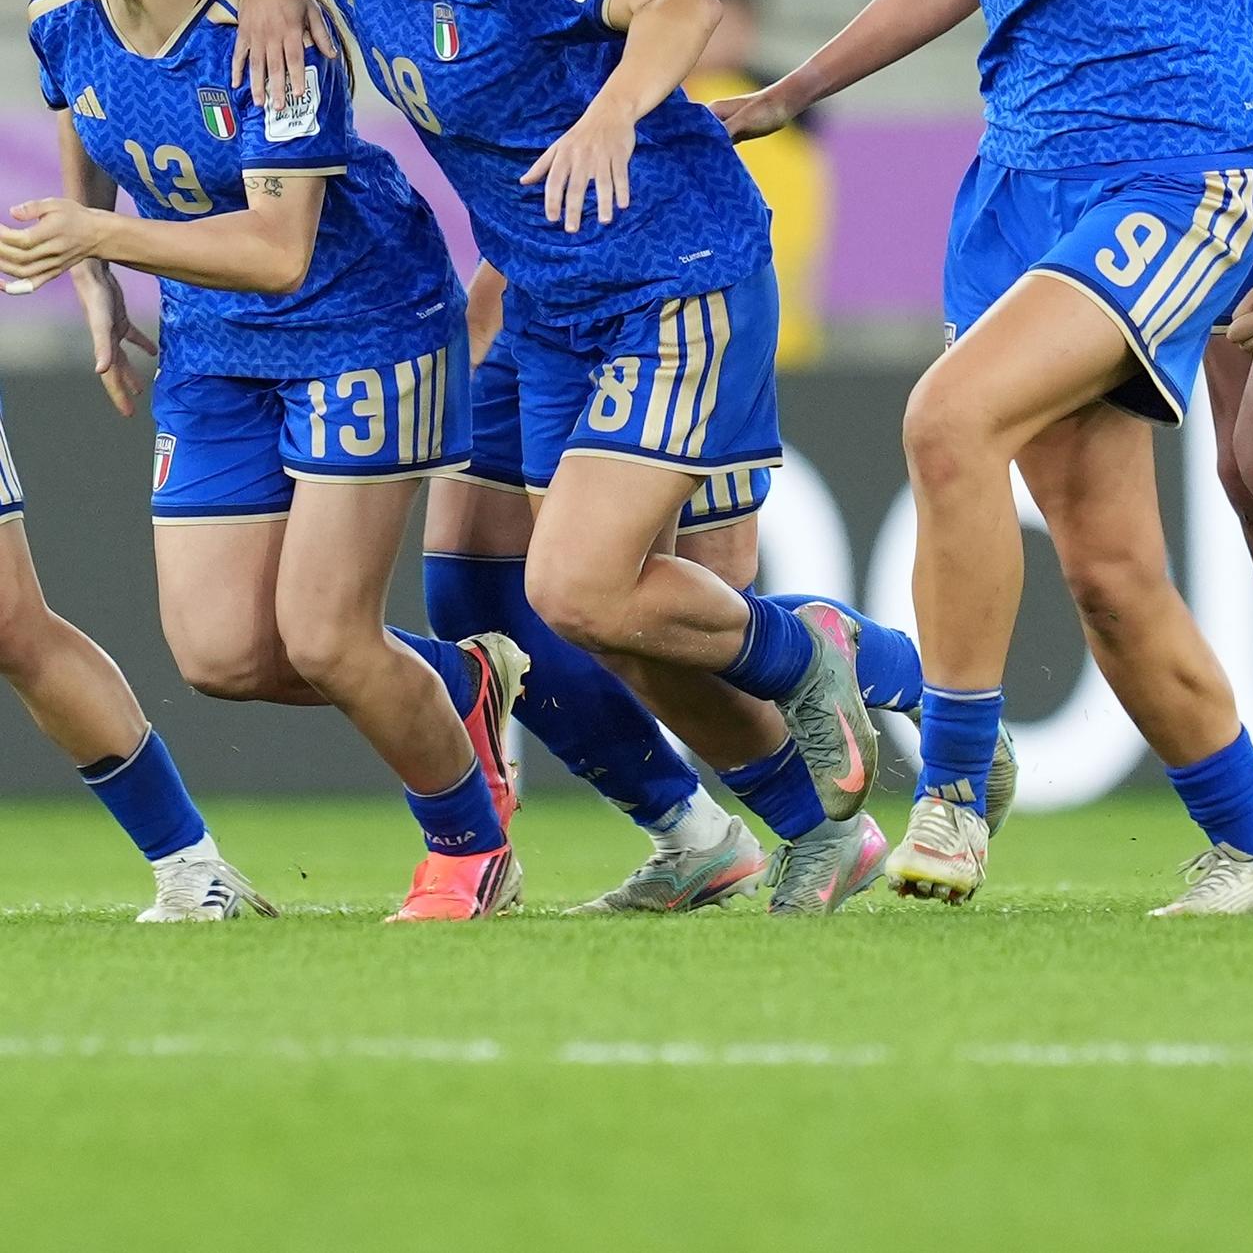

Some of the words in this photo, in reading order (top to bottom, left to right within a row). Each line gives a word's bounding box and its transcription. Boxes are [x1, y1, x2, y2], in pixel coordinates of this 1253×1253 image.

[284, 90, 312, 107] NITES
[371, 46, 442, 136] 18
[124, 139, 214, 215] 13
[1095, 212, 1167, 288] 9
[307, 367, 386, 459] 13
[588, 357, 641, 432] 8
